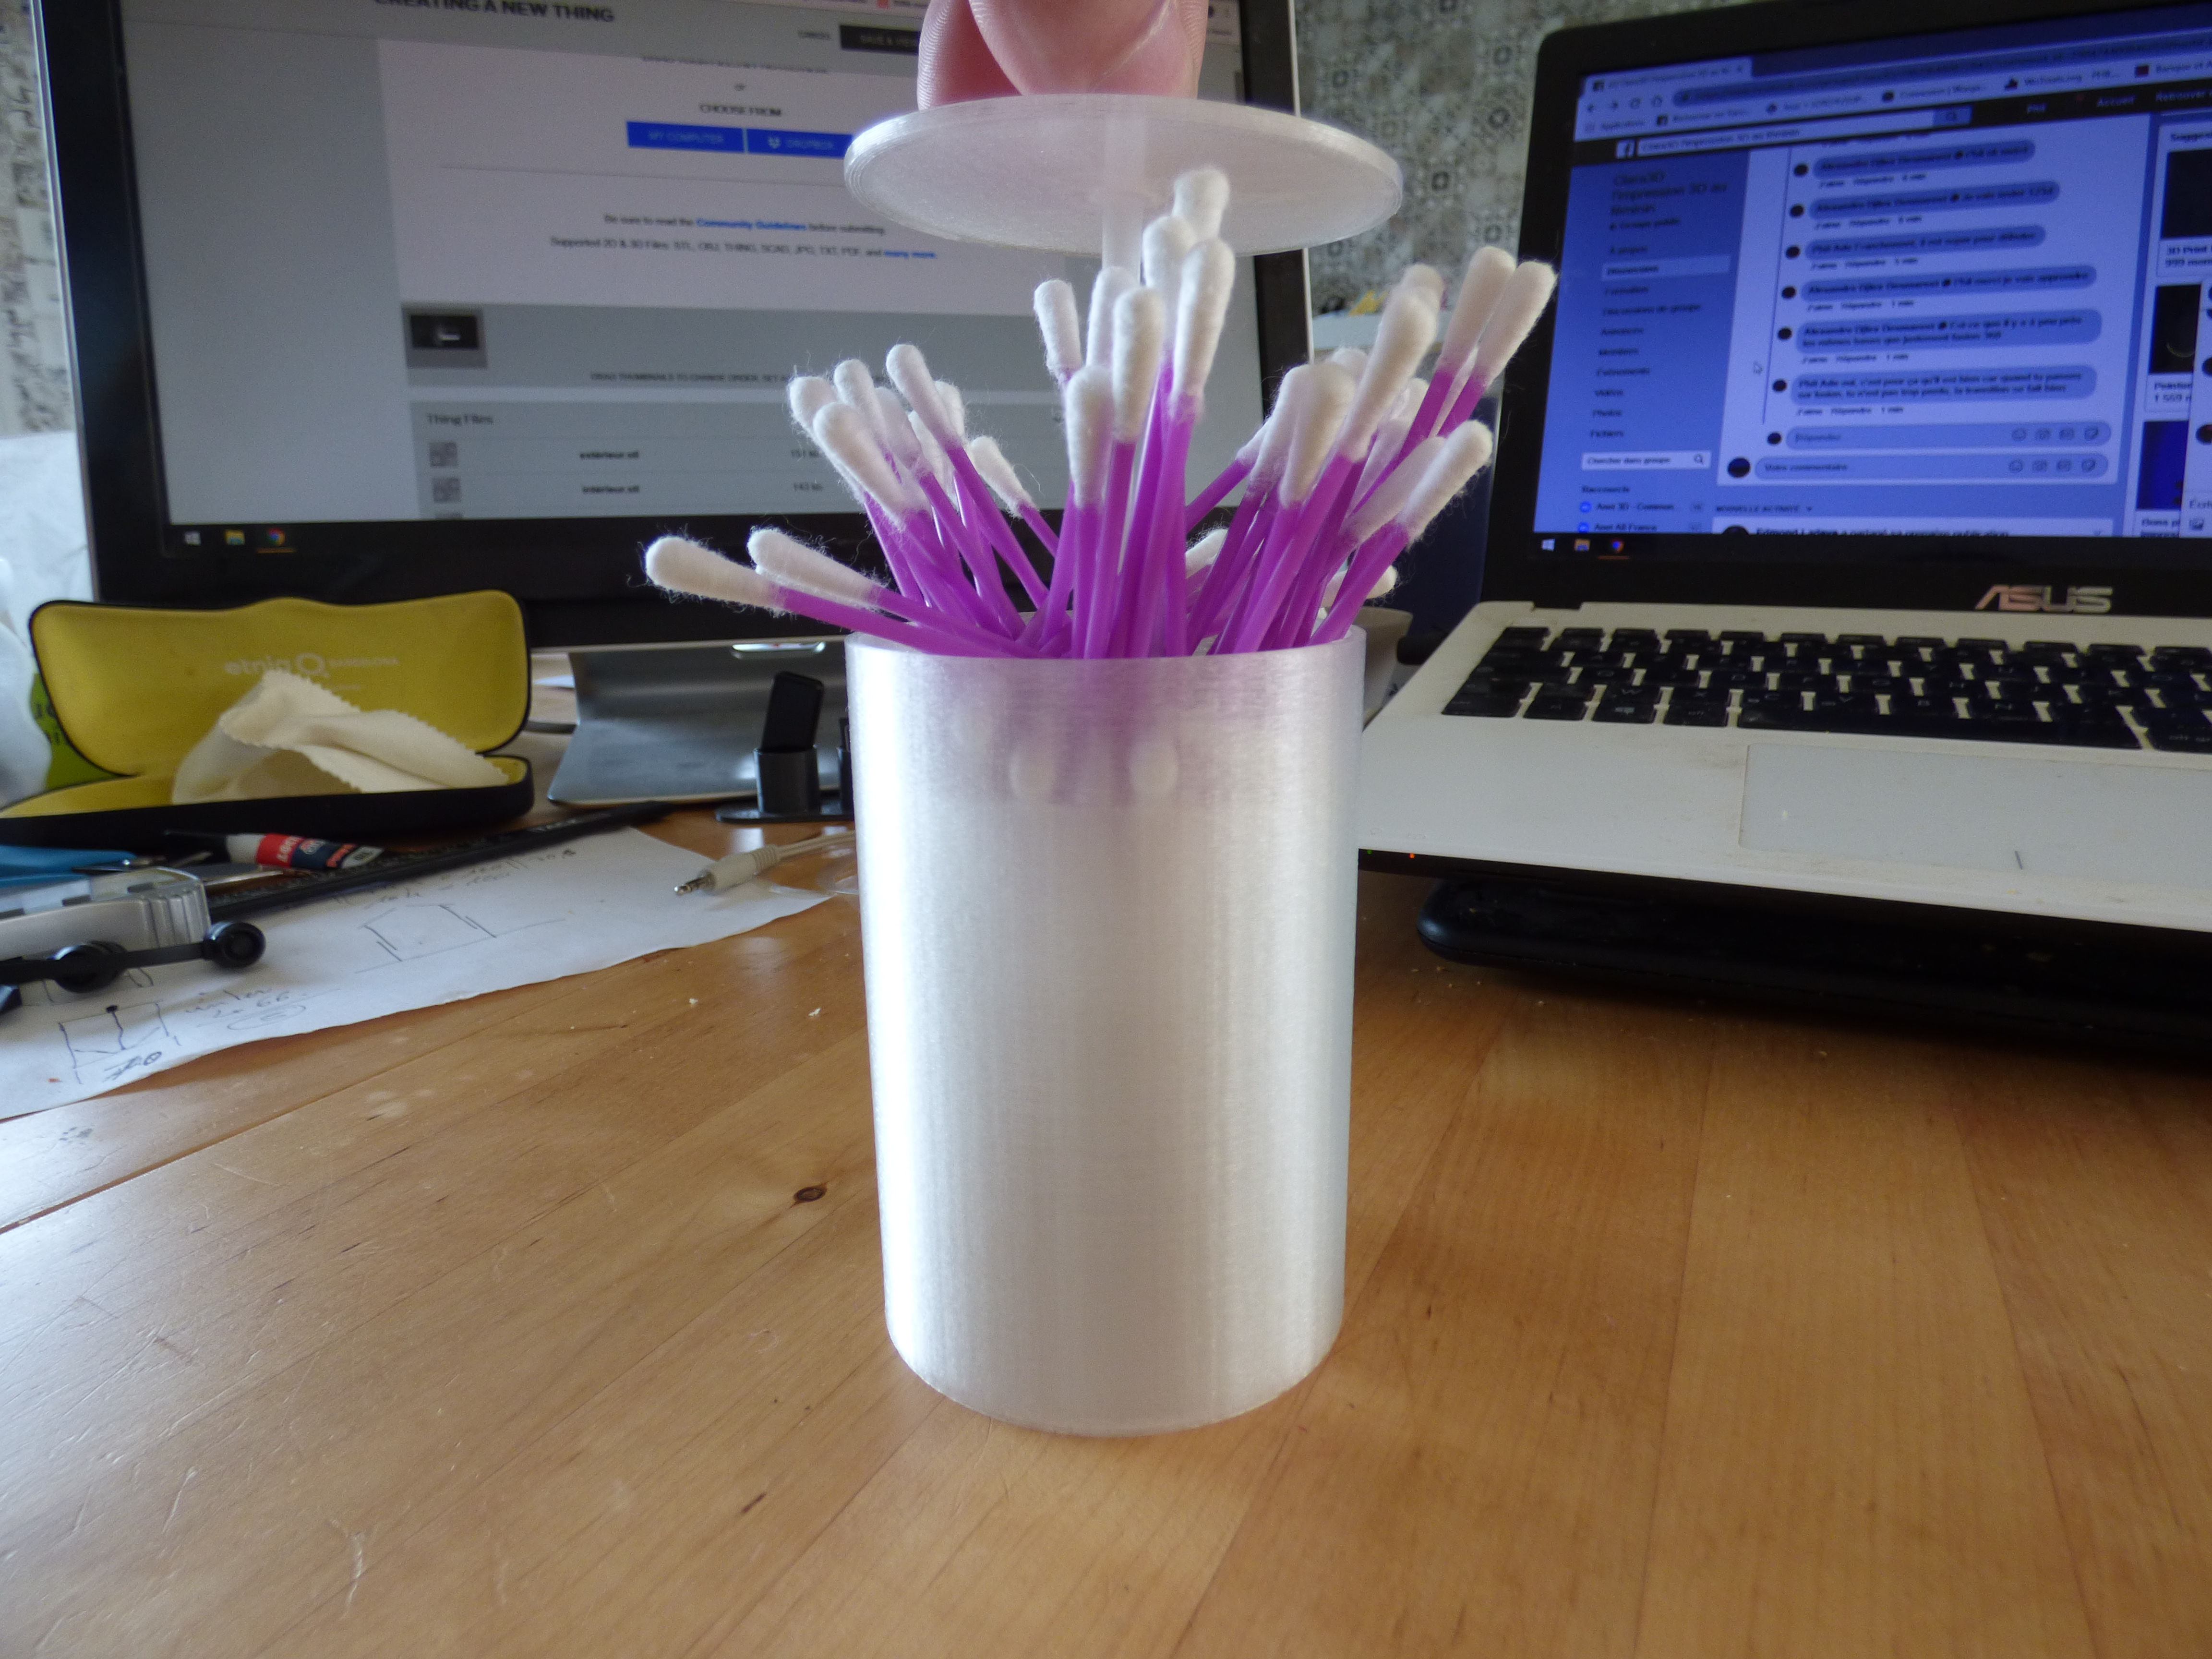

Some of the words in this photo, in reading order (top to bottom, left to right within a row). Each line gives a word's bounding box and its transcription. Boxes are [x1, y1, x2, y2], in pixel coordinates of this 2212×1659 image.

[502, 2, 548, 18] NEW
[554, 5, 615, 23] THING
[1974, 584, 2114, 613] ASUS
